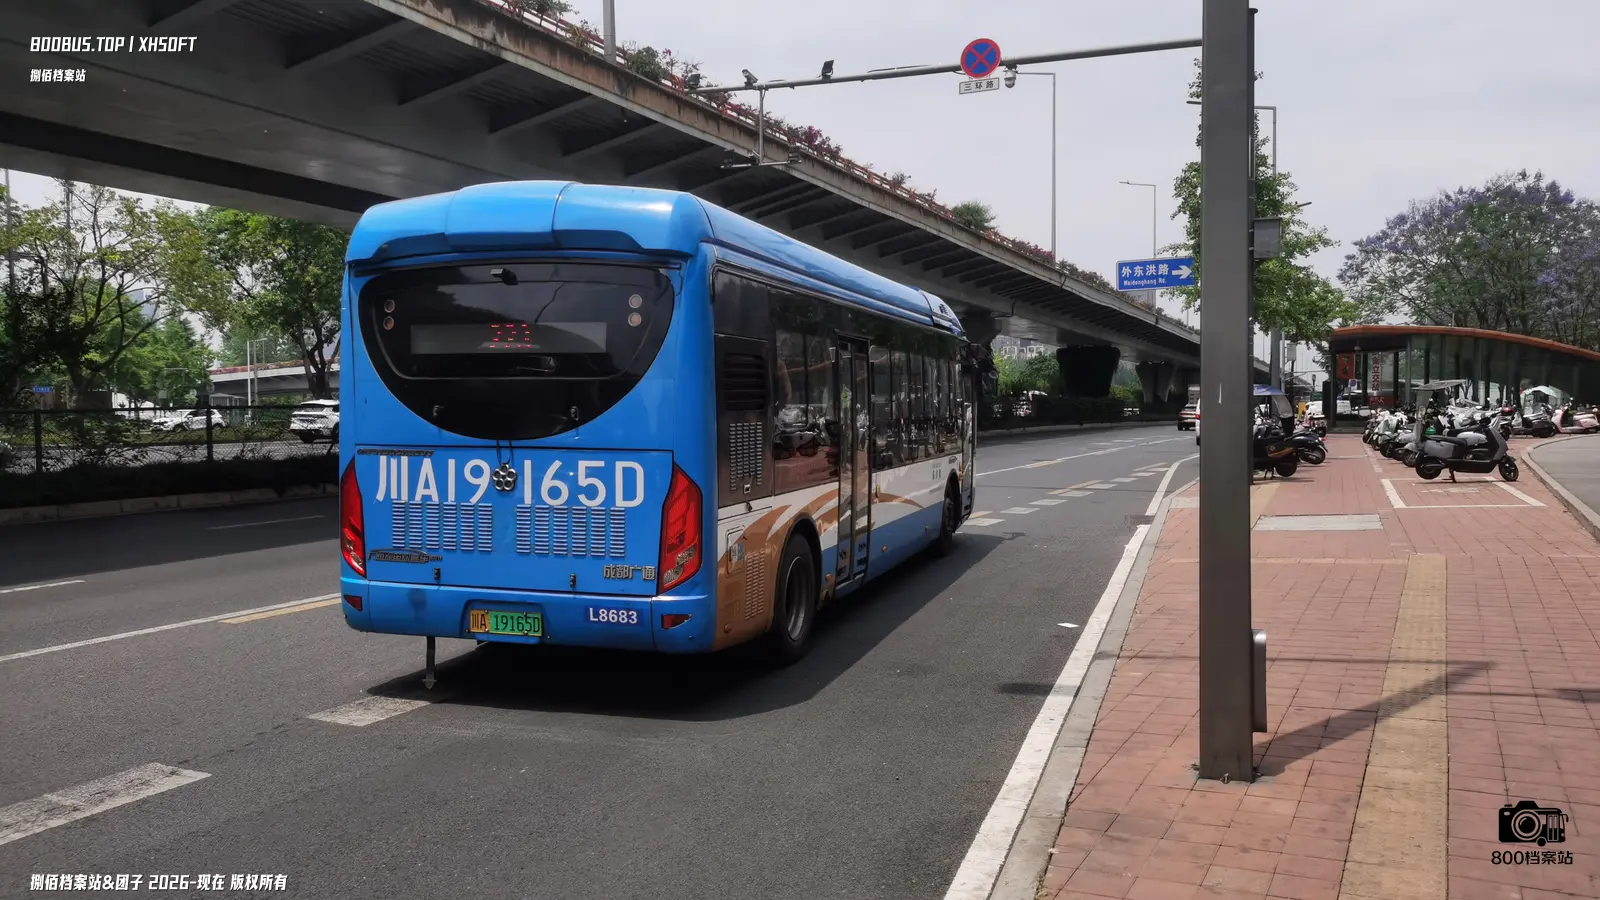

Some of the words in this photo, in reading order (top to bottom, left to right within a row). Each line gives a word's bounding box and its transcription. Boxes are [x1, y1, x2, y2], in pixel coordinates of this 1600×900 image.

[964, 81, 993, 91] 三环路
[1122, 263, 1169, 277] 外东洪路
[604, 564, 656, 581] 成都广通
[589, 607, 638, 624] L8683
